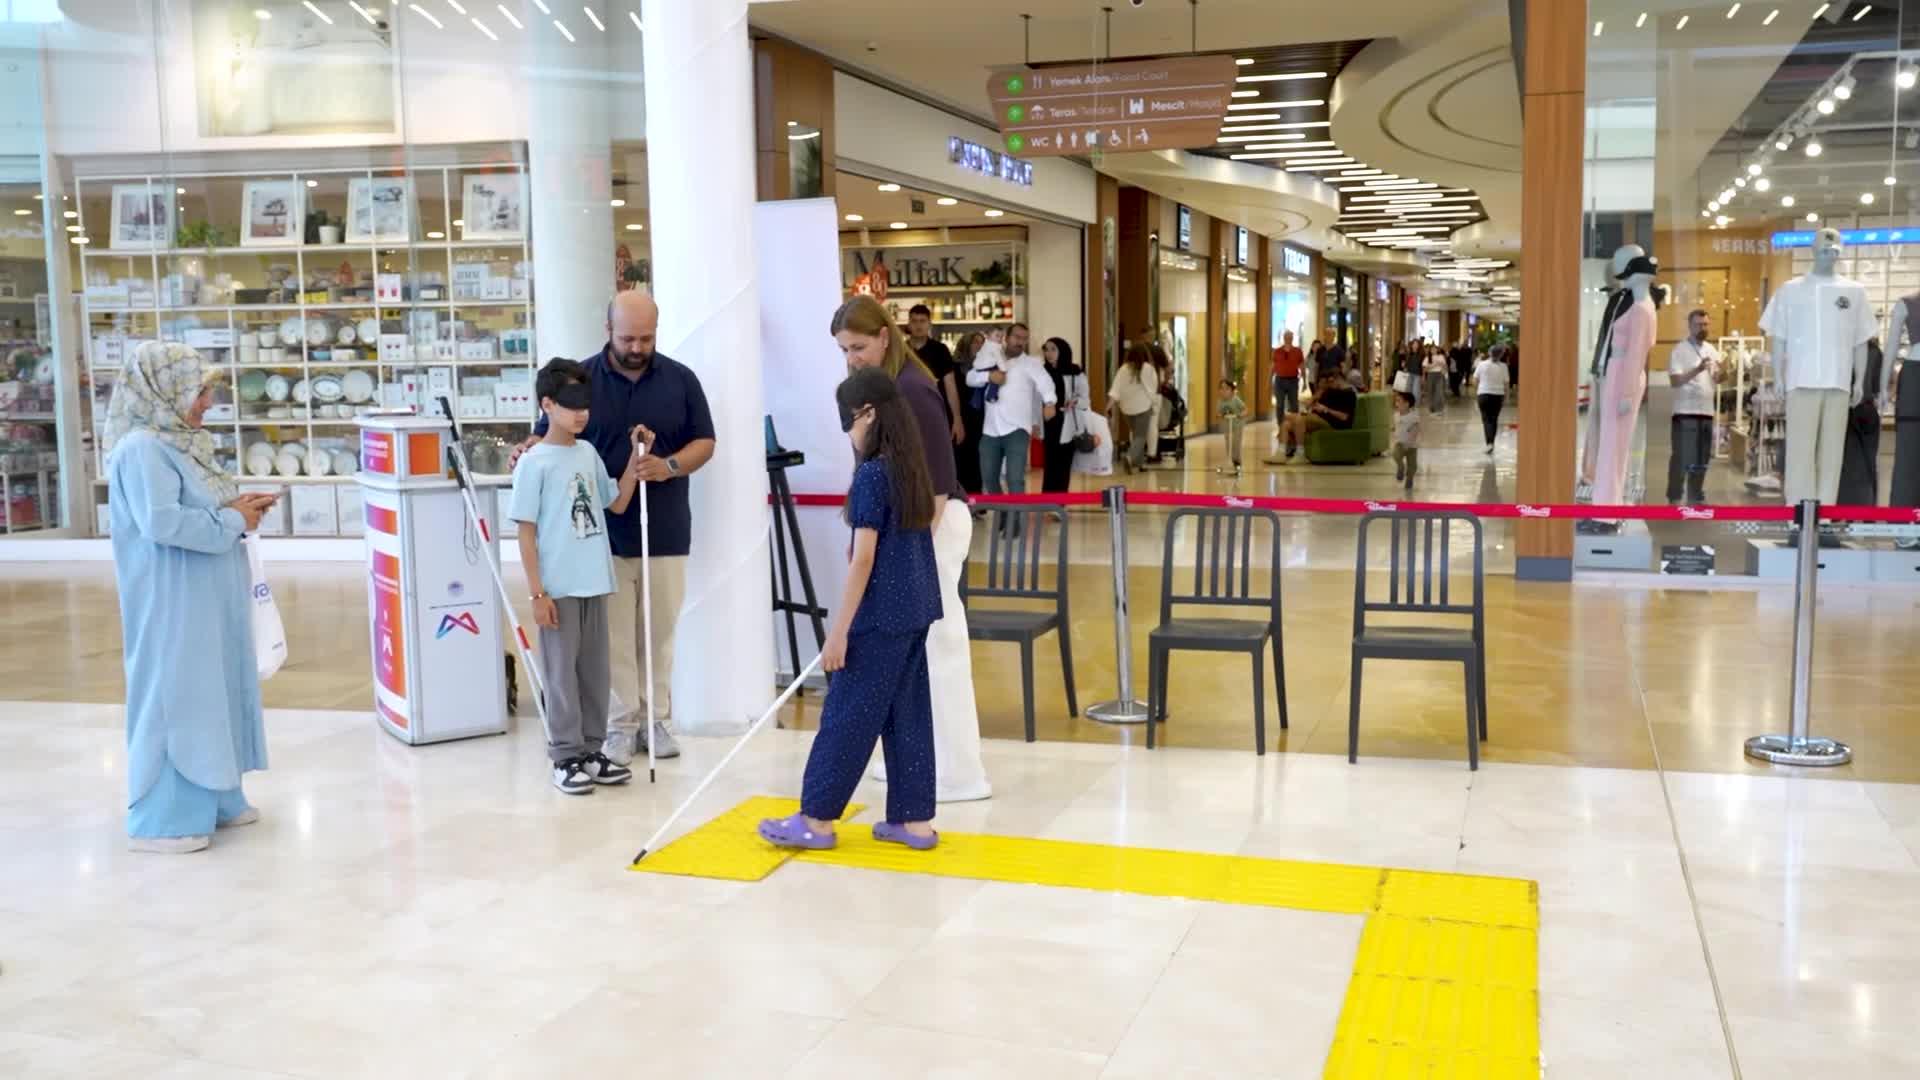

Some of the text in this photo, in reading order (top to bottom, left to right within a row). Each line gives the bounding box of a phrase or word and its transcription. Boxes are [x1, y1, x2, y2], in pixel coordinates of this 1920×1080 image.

[1151, 100, 1185, 112] Mescit
[1050, 107, 1077, 118] Teras
[1031, 136, 1049, 147] WC
